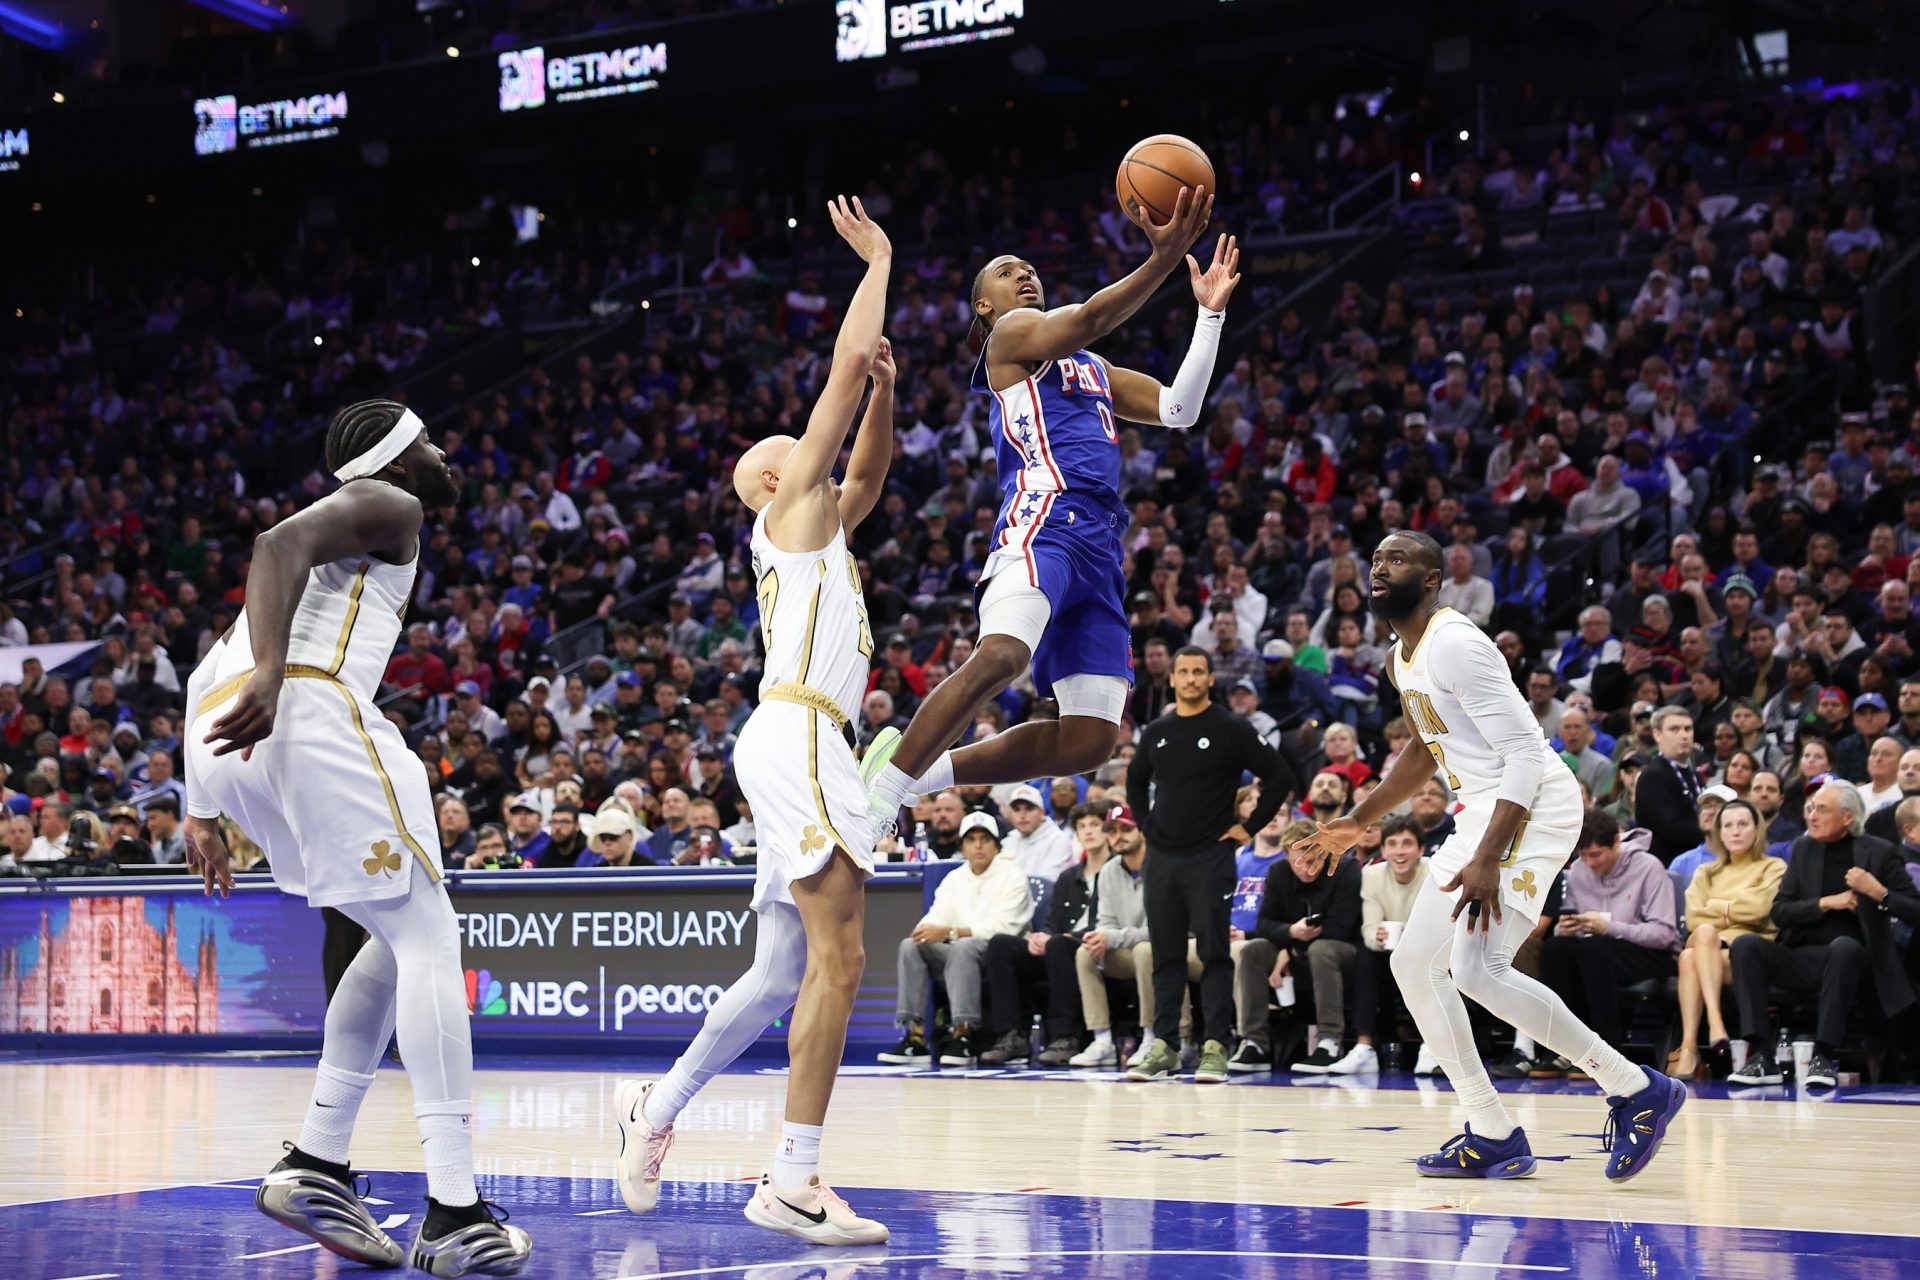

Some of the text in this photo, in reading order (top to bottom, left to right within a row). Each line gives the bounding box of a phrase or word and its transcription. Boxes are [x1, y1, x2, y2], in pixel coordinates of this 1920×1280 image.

[889, 0, 1024, 38] BETMGM
[547, 42, 667, 90] BETMGM
[238, 91, 348, 134] BETMGM
[1096, 400, 1119, 444] 0
[571, 910, 751, 948] FEBRUARY
[509, 980, 725, 1031] NBC peaco
